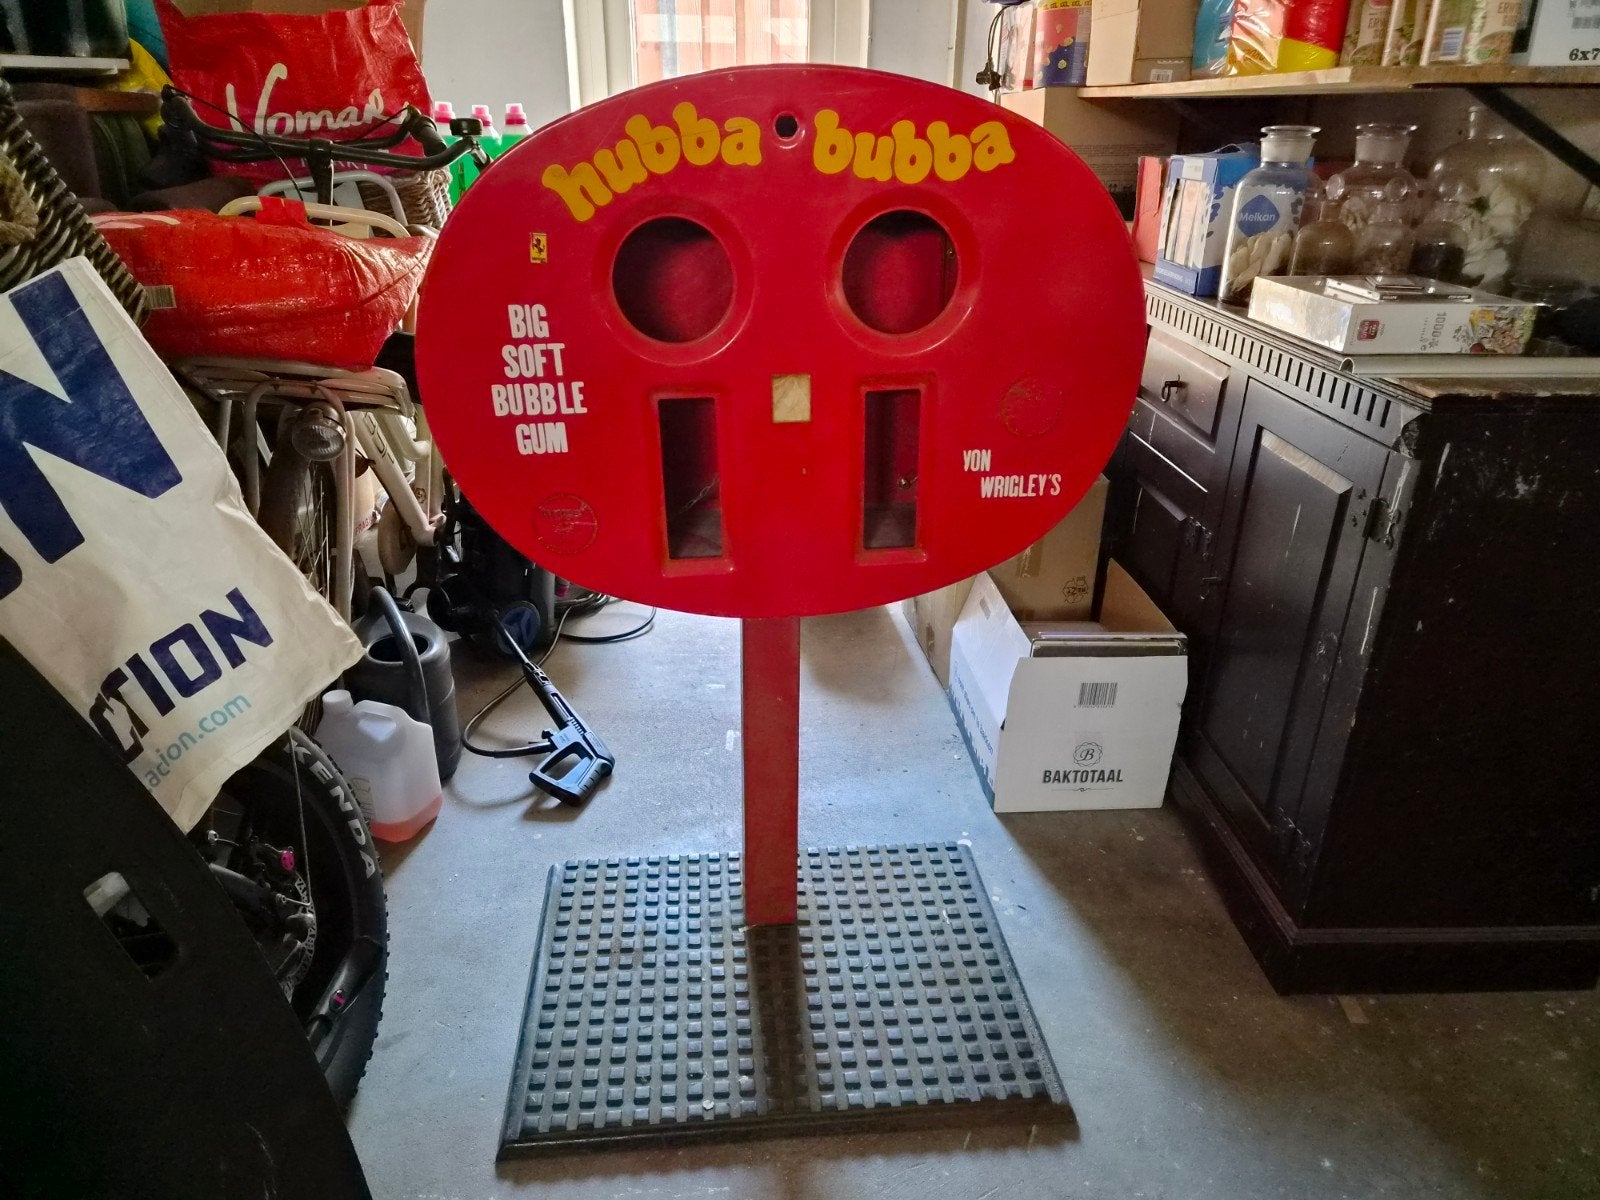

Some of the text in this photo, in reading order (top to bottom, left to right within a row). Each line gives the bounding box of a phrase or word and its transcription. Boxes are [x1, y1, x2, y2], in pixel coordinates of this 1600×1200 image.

[813, 109, 1016, 185] bubba
[507, 303, 550, 339] BIG
[501, 343, 565, 379] SOFT
[491, 381, 588, 417] BUBBLE
[515, 422, 569, 456] GUM
[981, 473, 1062, 499] WRIGLEY'S
[1042, 769, 1124, 784] BAKTOTAAL
[282, 738, 376, 879] KENDA
